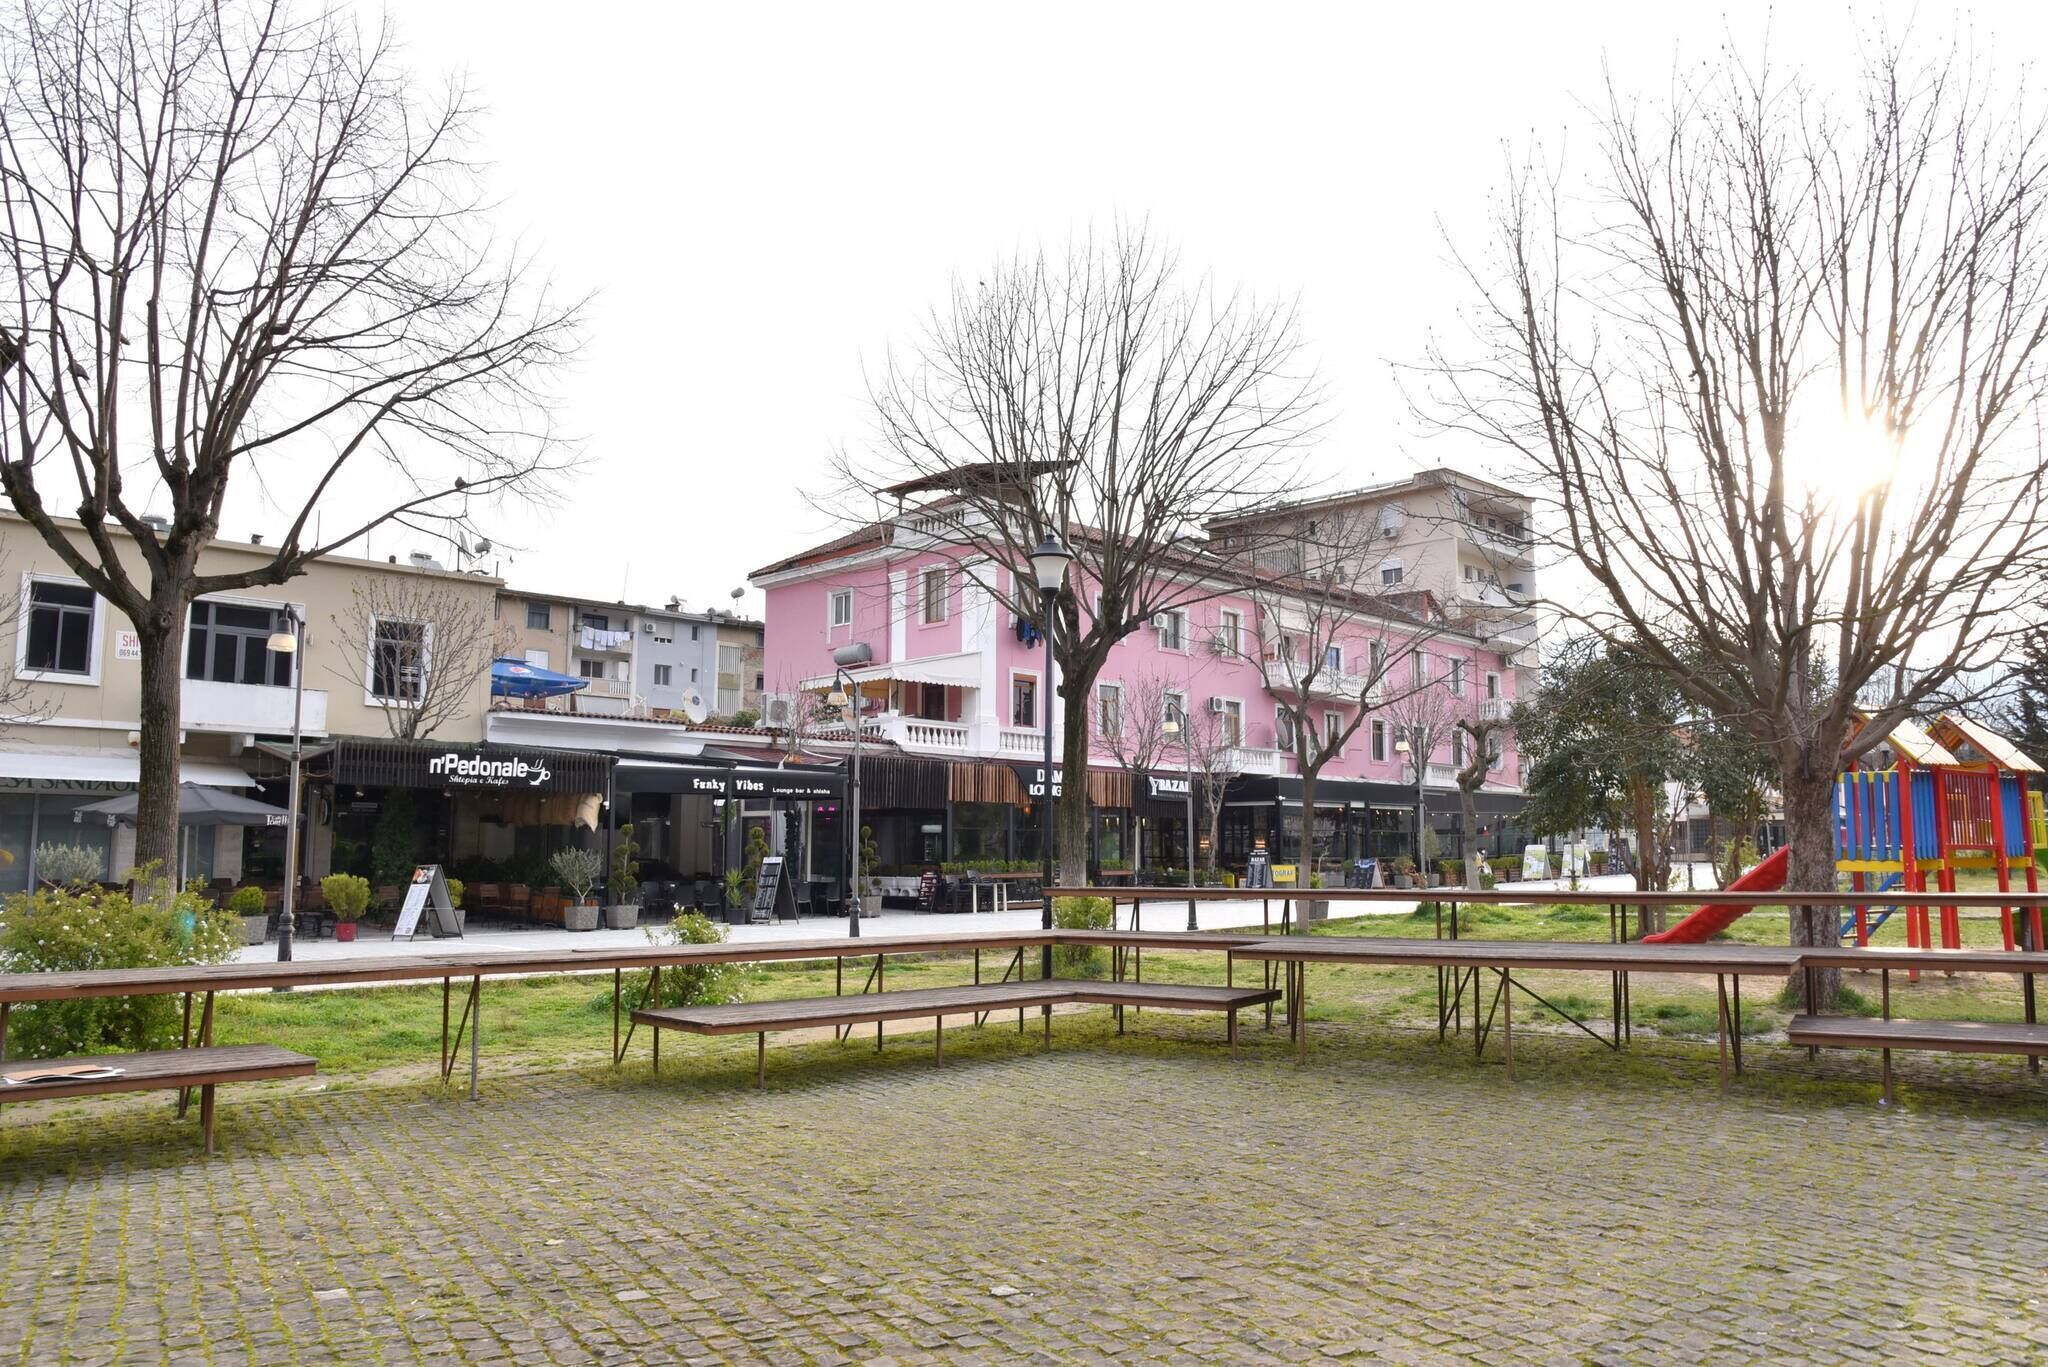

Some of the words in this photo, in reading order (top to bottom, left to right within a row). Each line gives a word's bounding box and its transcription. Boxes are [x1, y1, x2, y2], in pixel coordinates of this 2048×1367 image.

[429, 753, 529, 777] n'Pedonale
[692, 778, 726, 792] Funky
[735, 779, 765, 791] Vibes
[772, 787, 793, 795] Lounge
